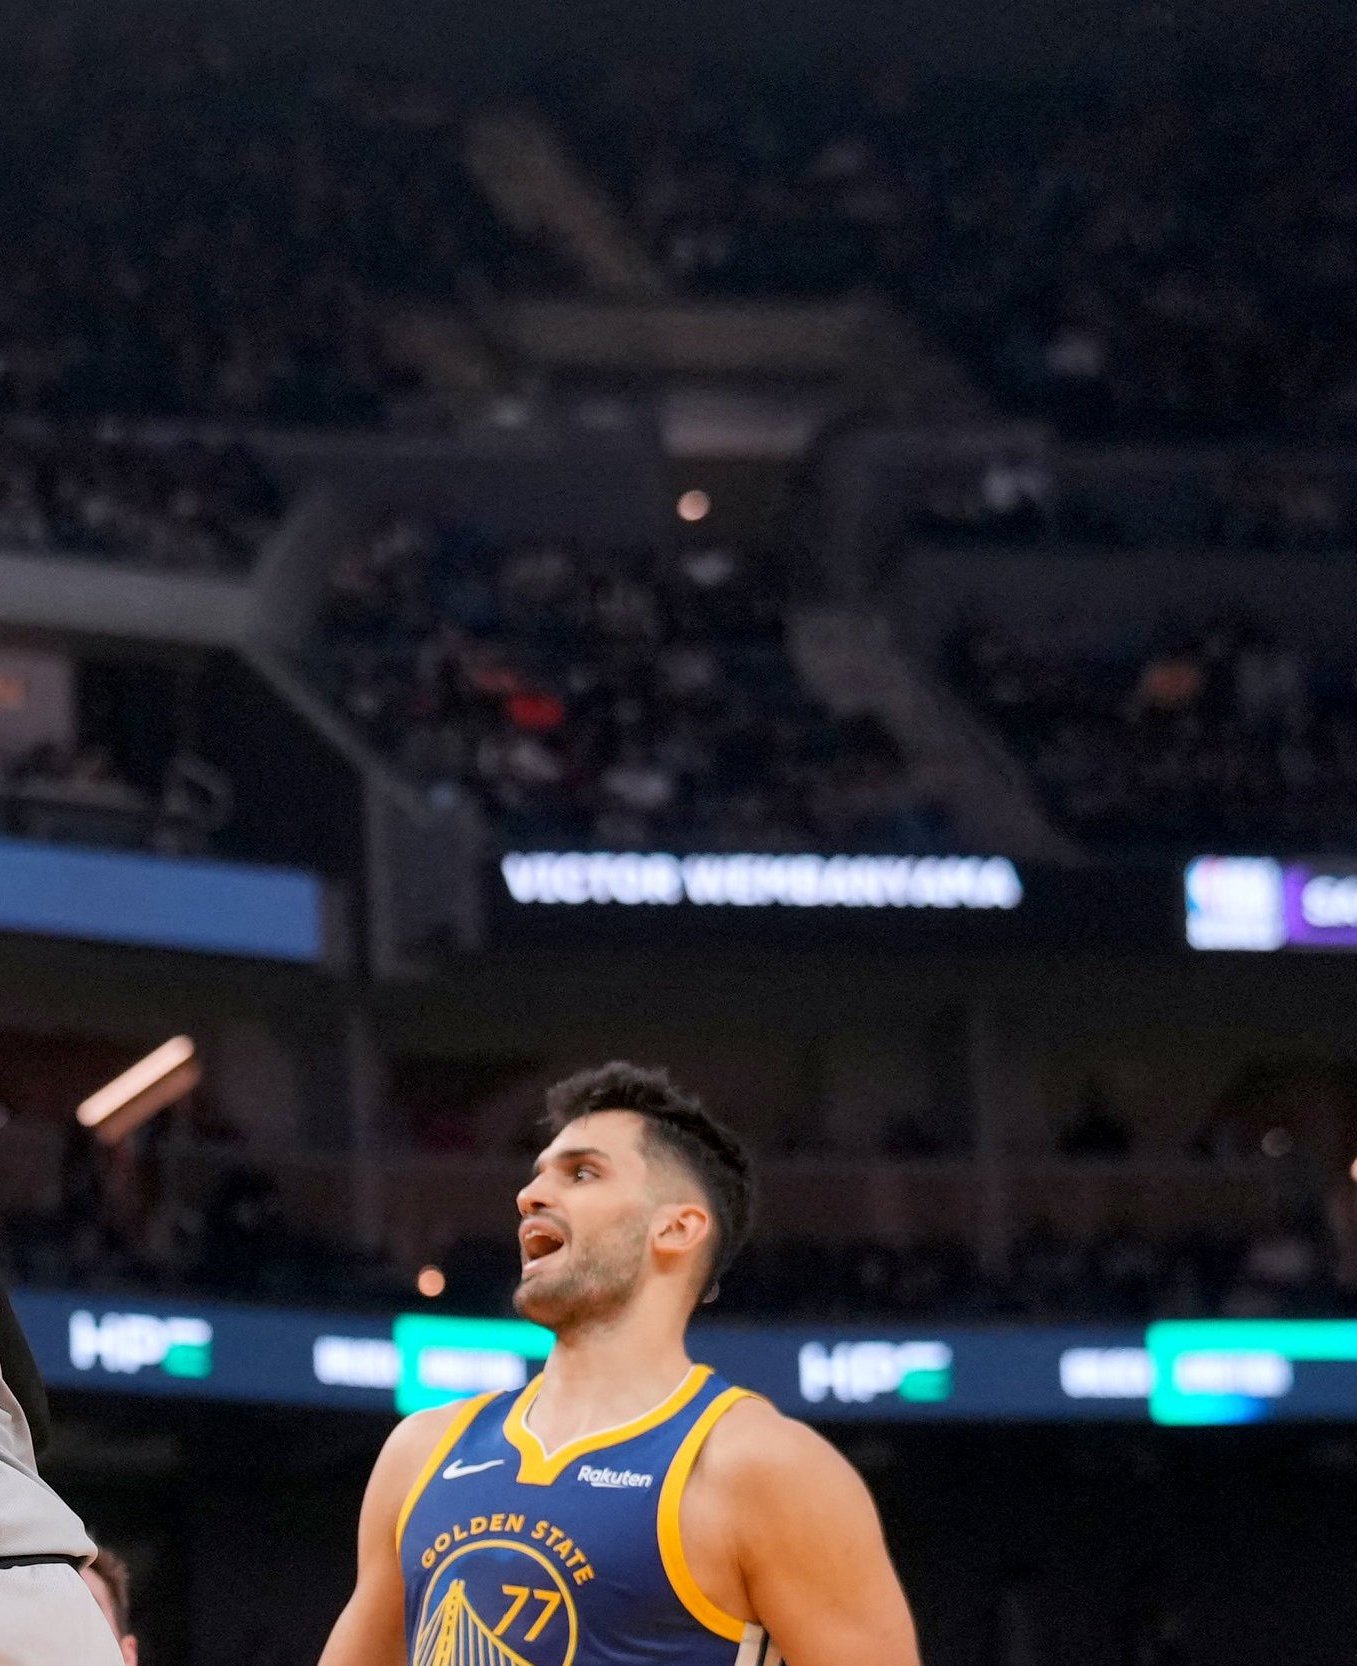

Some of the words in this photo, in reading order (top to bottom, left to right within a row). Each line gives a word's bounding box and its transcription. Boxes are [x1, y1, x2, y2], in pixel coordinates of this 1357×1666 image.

[501, 852, 683, 905] VICTOR
[69, 1310, 213, 1378] HPE
[798, 1340, 953, 1403] HPE
[576, 1465, 653, 1488] Rakuten
[420, 1513, 525, 1570] GOLDEN
[532, 1520, 597, 1586] STATE
[495, 1584, 562, 1642] 77
